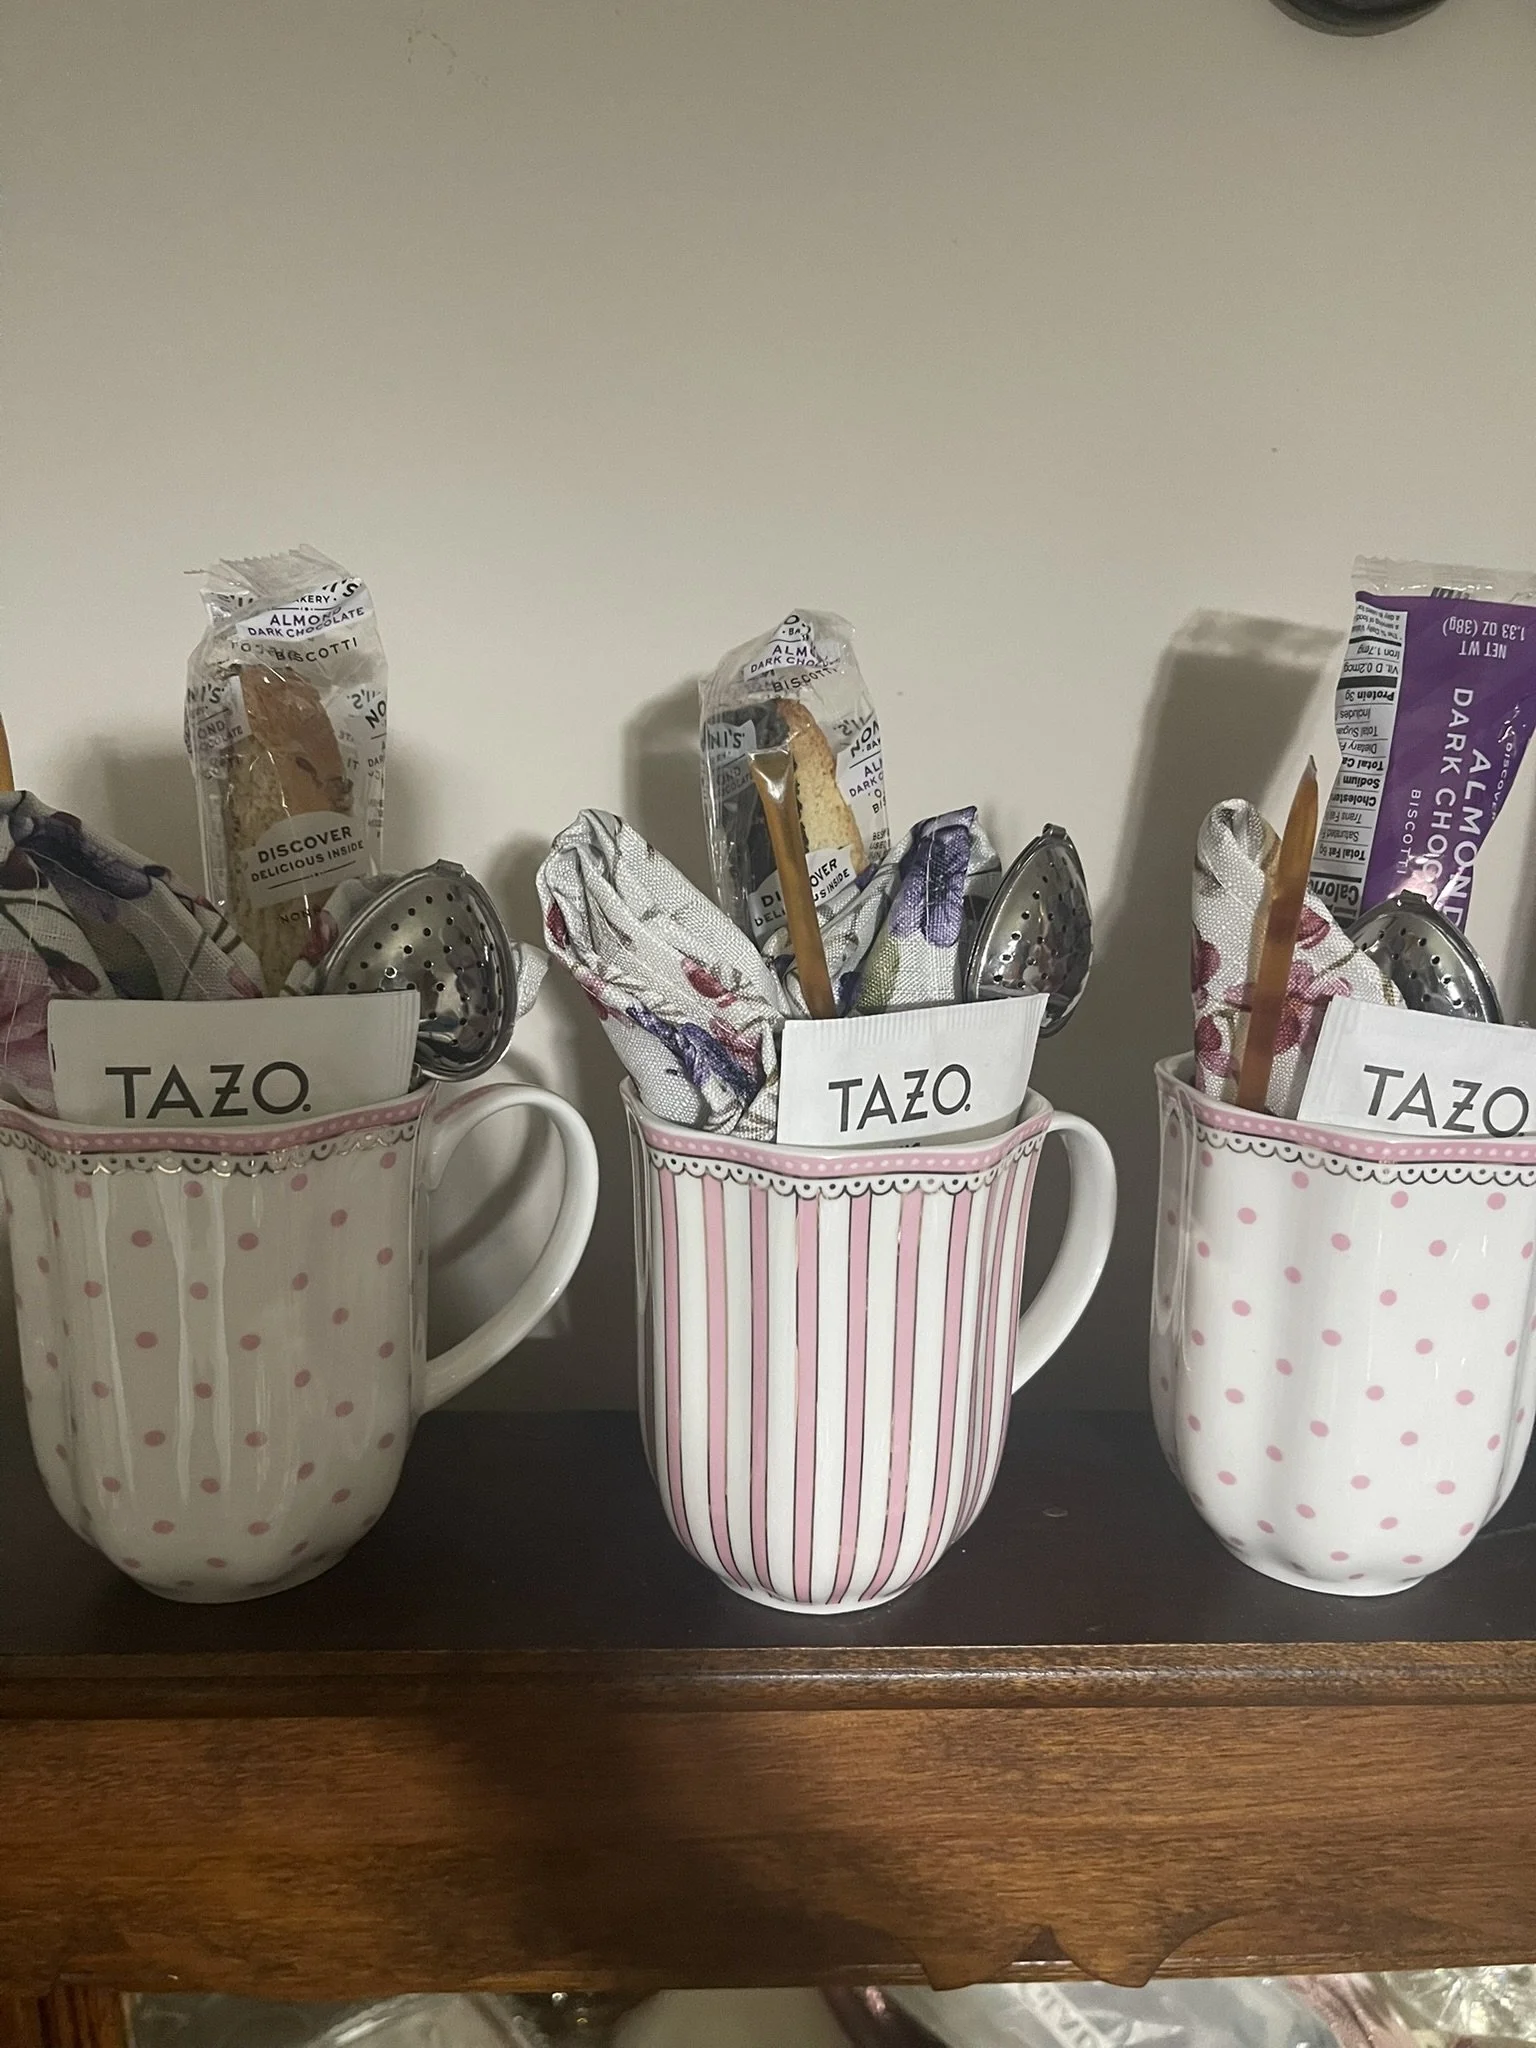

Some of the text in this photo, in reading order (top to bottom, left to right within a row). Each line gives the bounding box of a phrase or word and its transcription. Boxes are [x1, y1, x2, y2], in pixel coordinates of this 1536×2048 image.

[296, 595, 330, 604] KERY
[248, 606, 365, 638] DARK CHOCOLATE
[270, 607, 342, 626] ALMOND
[1442, 616, 1525, 641] 1.33 OZ (38g)
[275, 637, 358, 662] BISCOTTI
[1384, 649, 1400, 660] Iron
[1459, 640, 1507, 659] NET WT
[751, 656, 781, 673] DARK
[1375, 663, 1383, 673] D
[1386, 664, 1399, 675] Vit.
[1345, 690, 1395, 701] Protein 3g
[1340, 708, 1370, 722] Includes
[1360, 726, 1378, 737] Total
[1440, 688, 1474, 775] DARK
[1348, 741, 1377, 754] Dietary
[1357, 759, 1384, 771] Total
[849, 778, 878, 798] DARK
[1343, 776, 1380, 788] Sodium
[1342, 812, 1362, 824] Trans
[1397, 789, 1422, 875] BISCOTTI
[257, 826, 353, 864] DISCOVER
[1328, 847, 1341, 858] Fat
[1342, 849, 1366, 861] Total
[251, 840, 365, 883] DELICIOUS INSIDE
[826, 868, 850, 894] INSIDE
